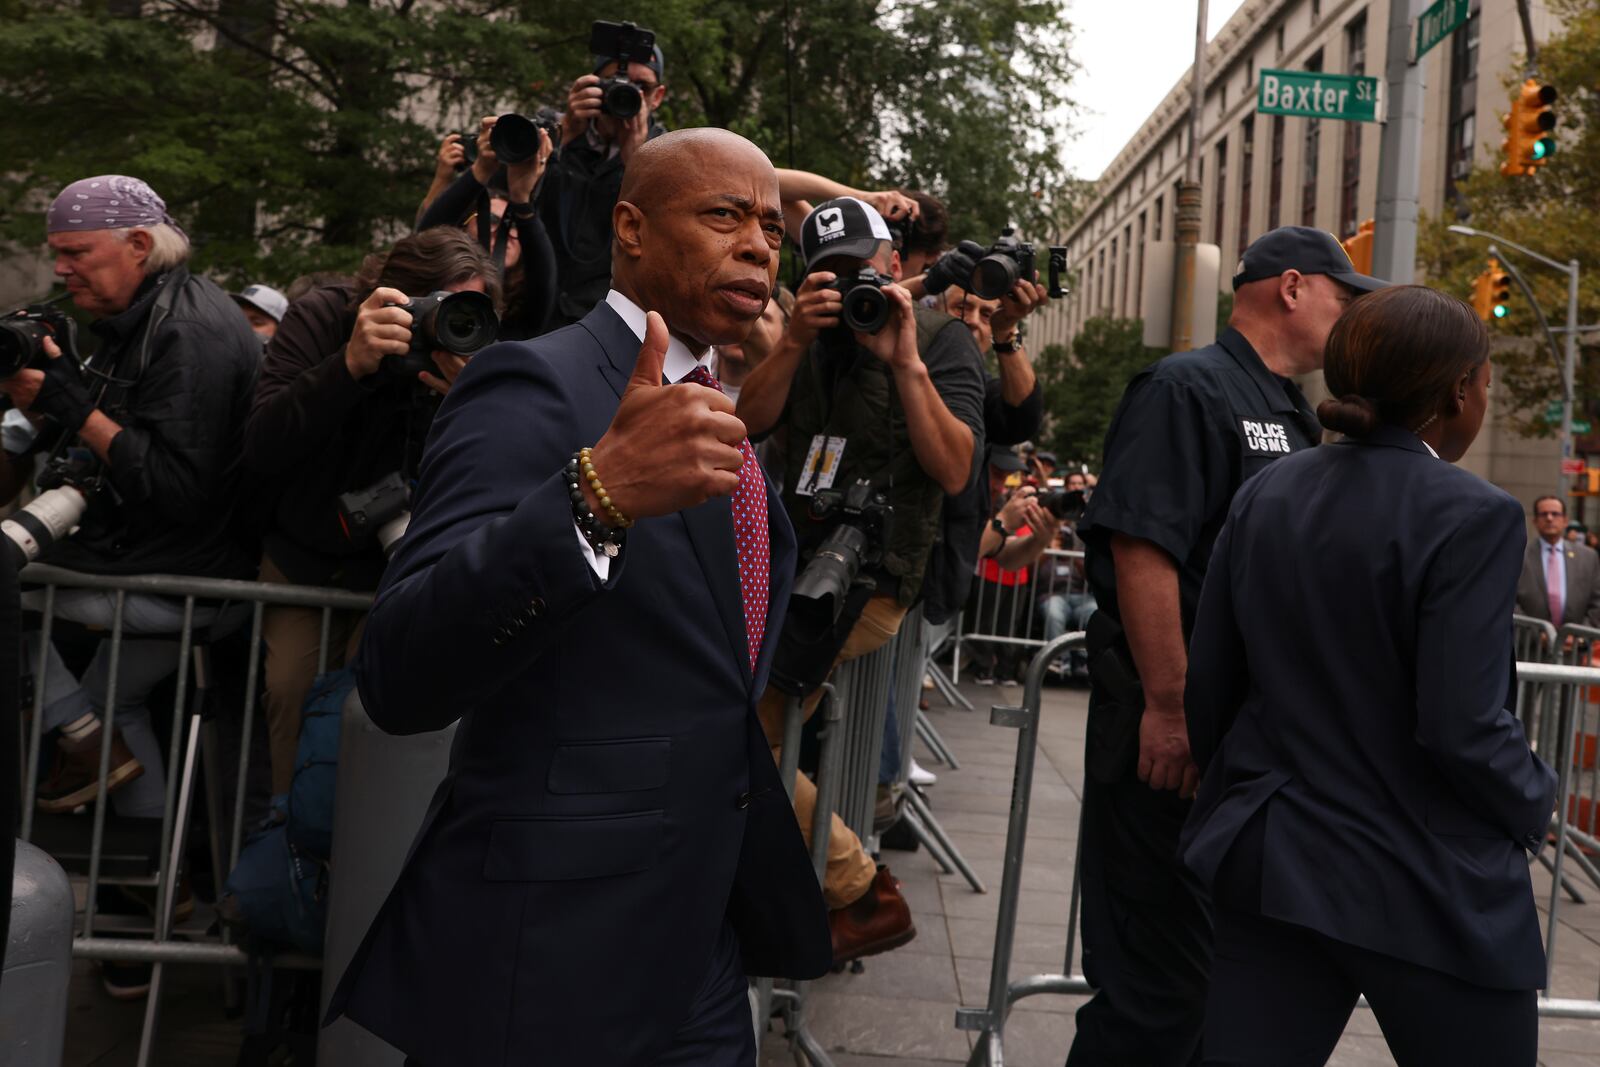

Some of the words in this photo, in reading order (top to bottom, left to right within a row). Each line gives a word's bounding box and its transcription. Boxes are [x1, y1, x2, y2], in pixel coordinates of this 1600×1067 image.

[1263, 75, 1348, 113] Baxter
[1356, 80, 1371, 101] St
[1242, 420, 1288, 440] POLICE
[1247, 436, 1291, 453] USMS
